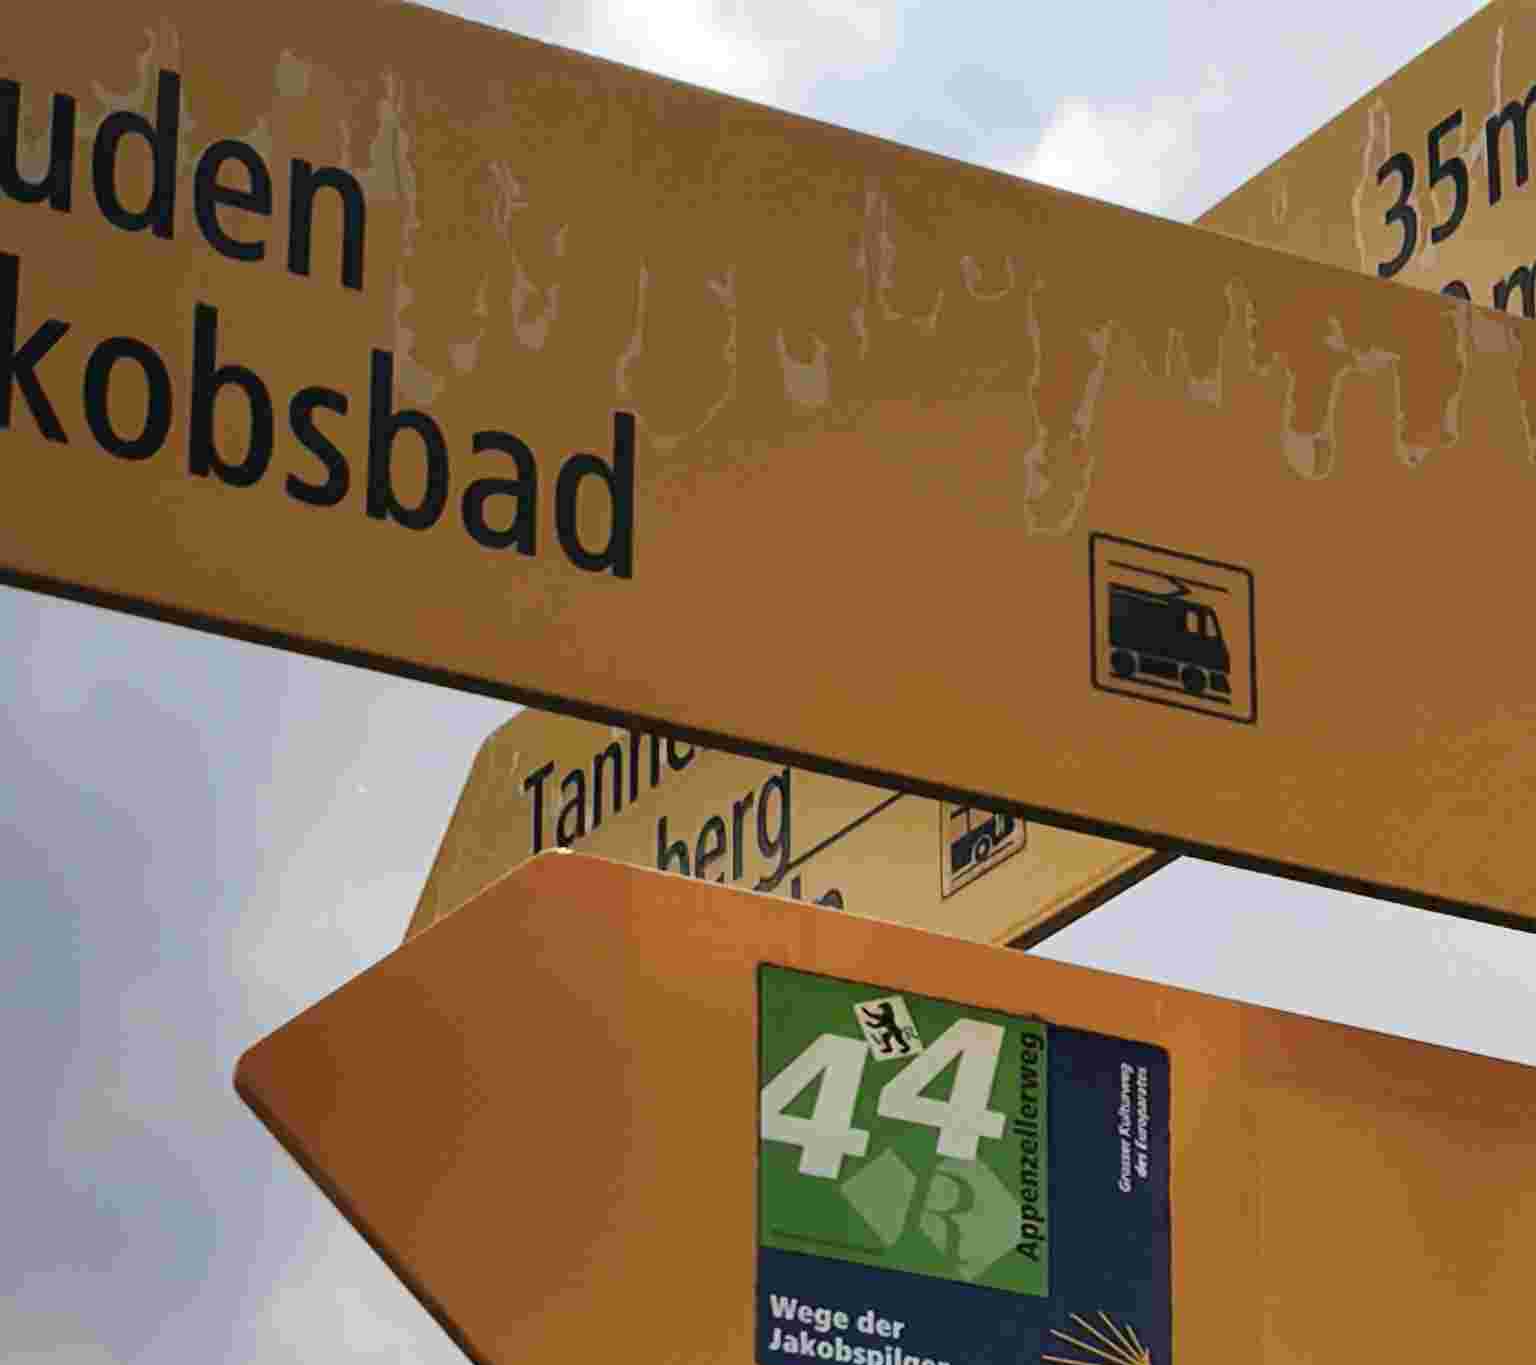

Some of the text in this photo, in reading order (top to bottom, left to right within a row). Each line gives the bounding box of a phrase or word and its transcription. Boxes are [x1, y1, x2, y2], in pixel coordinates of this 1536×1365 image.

[0, 69, 367, 291] uden
[0, 252, 637, 580] kobsbad
[761, 1017, 1008, 1180] 44
[1015, 1030, 1046, 1263] Appenzellerweg
[769, 1294, 905, 1341] Wege der
